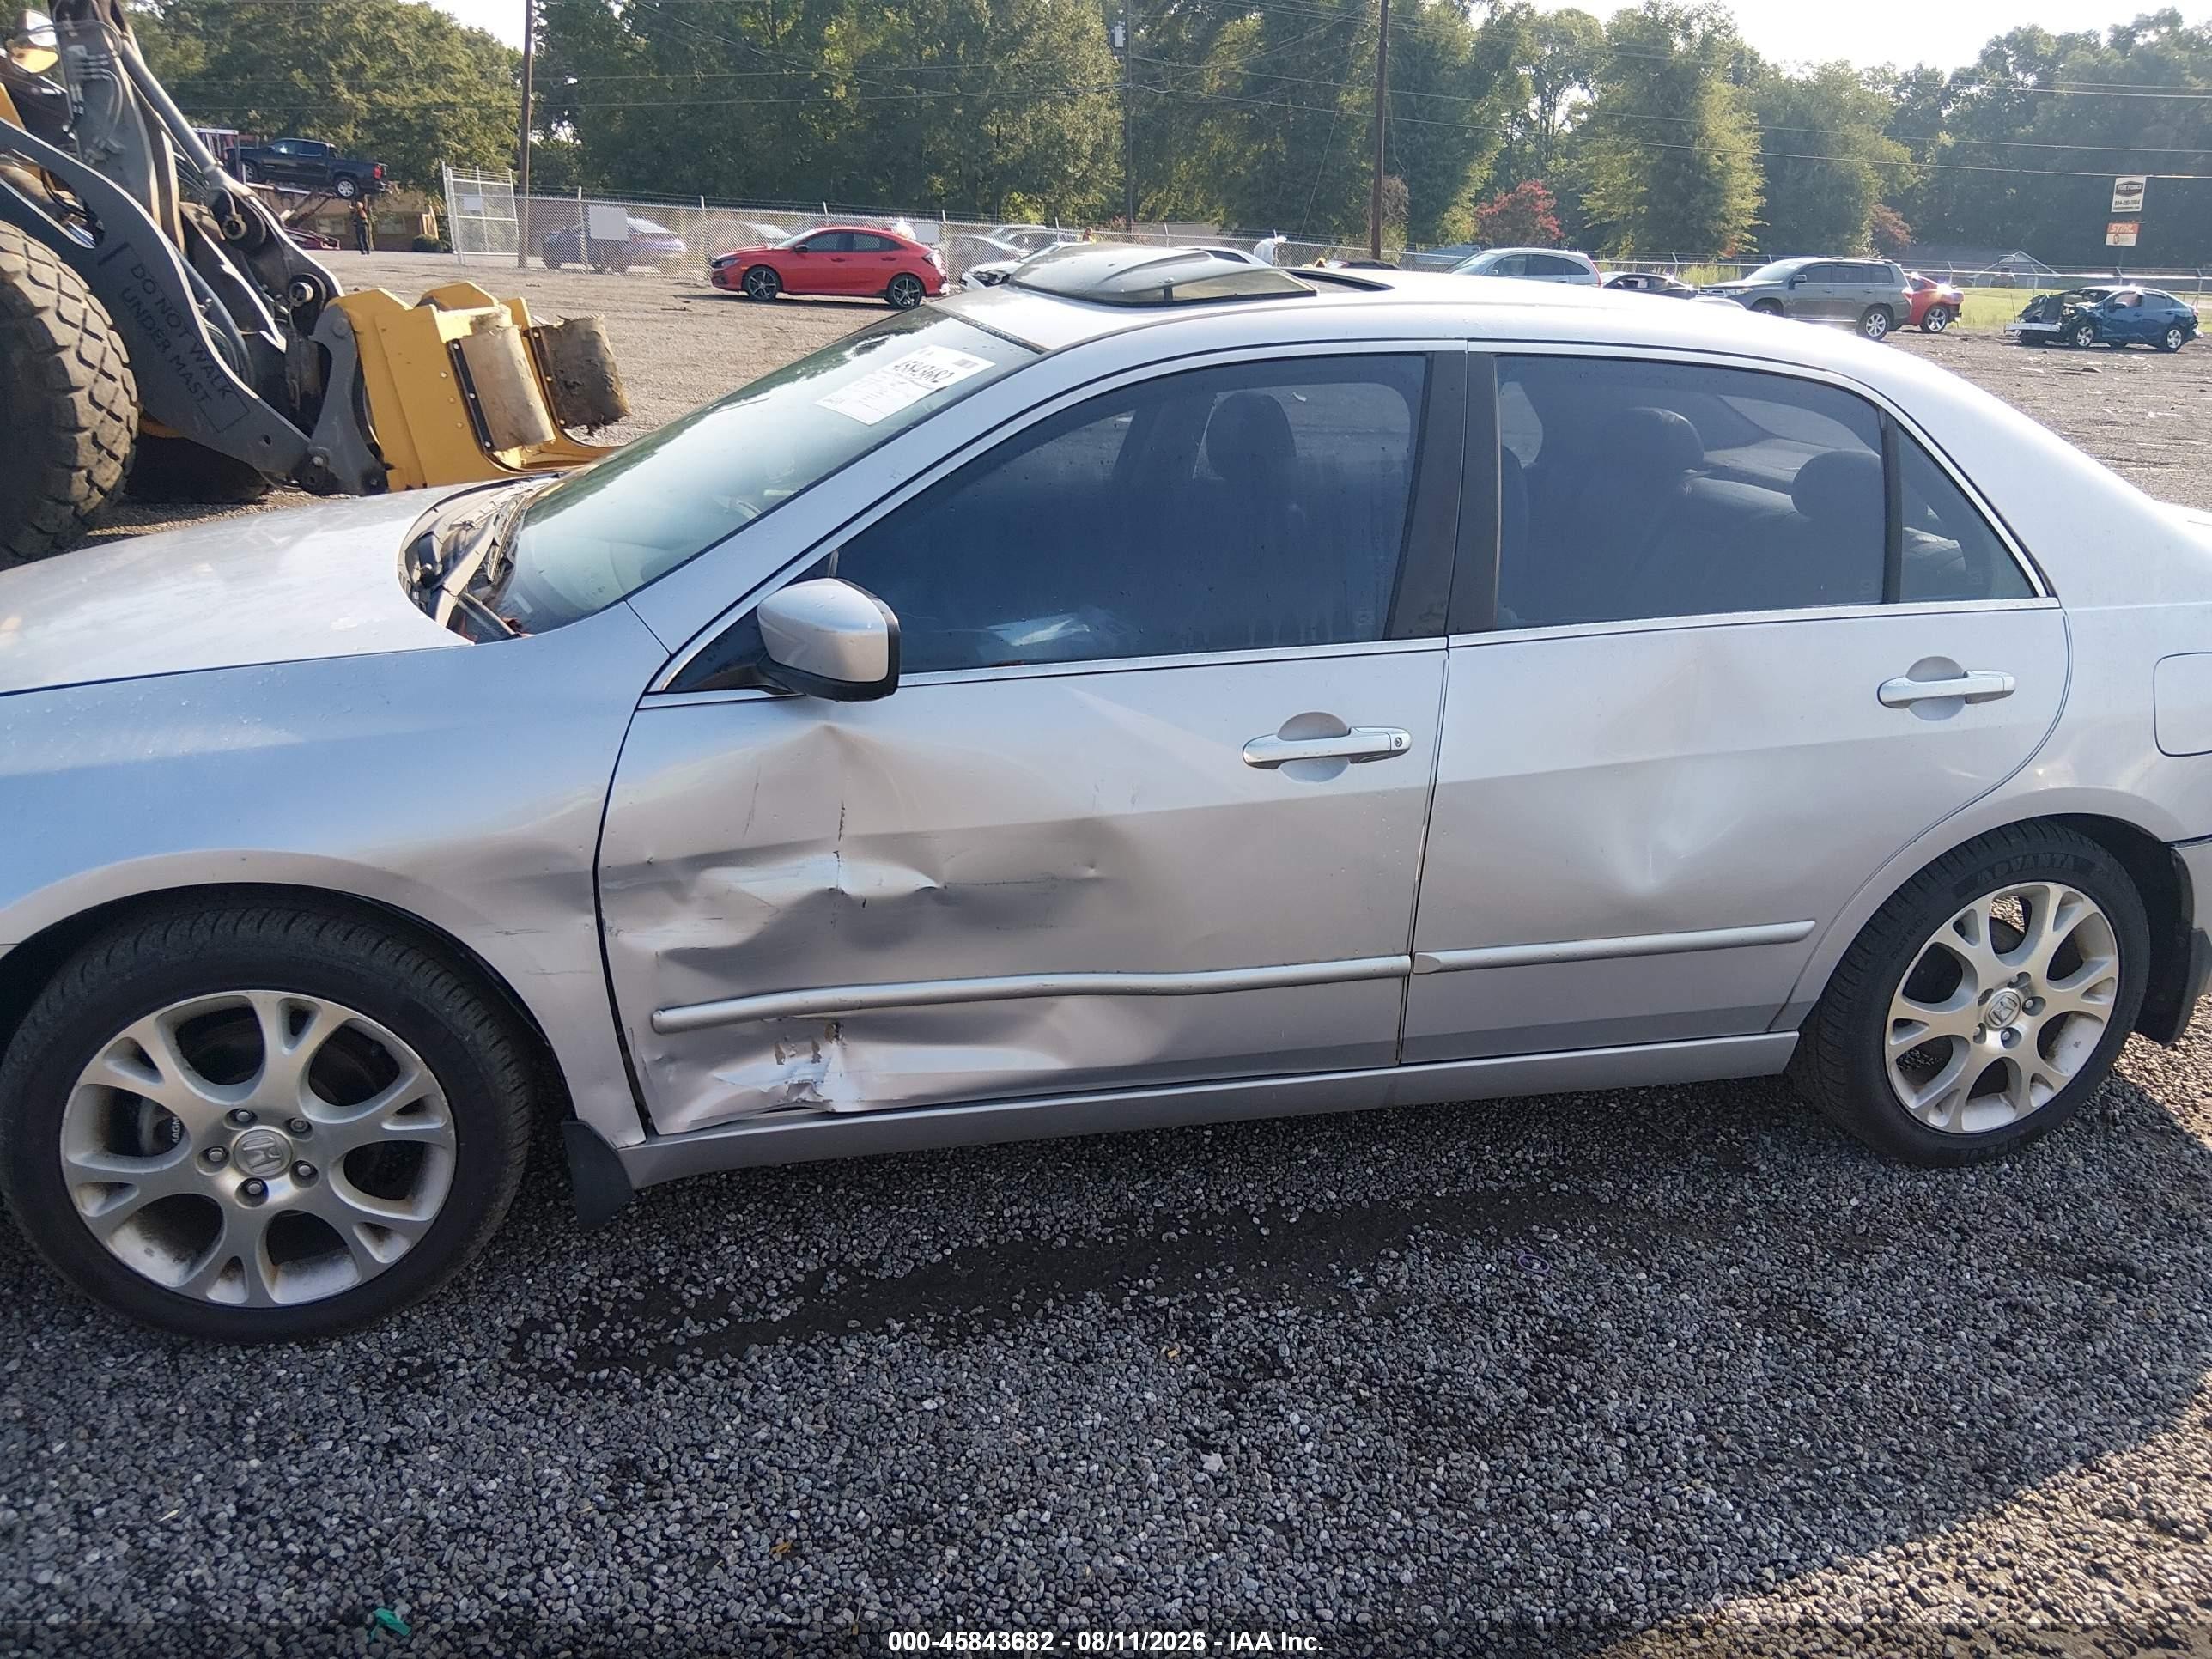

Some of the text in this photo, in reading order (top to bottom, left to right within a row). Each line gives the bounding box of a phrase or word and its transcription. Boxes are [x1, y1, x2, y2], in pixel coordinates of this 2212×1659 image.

[2111, 224, 2135, 233] STIHL
[121, 288, 213, 402] UNDER MAST
[131, 264, 233, 398] DO NOT WALK
